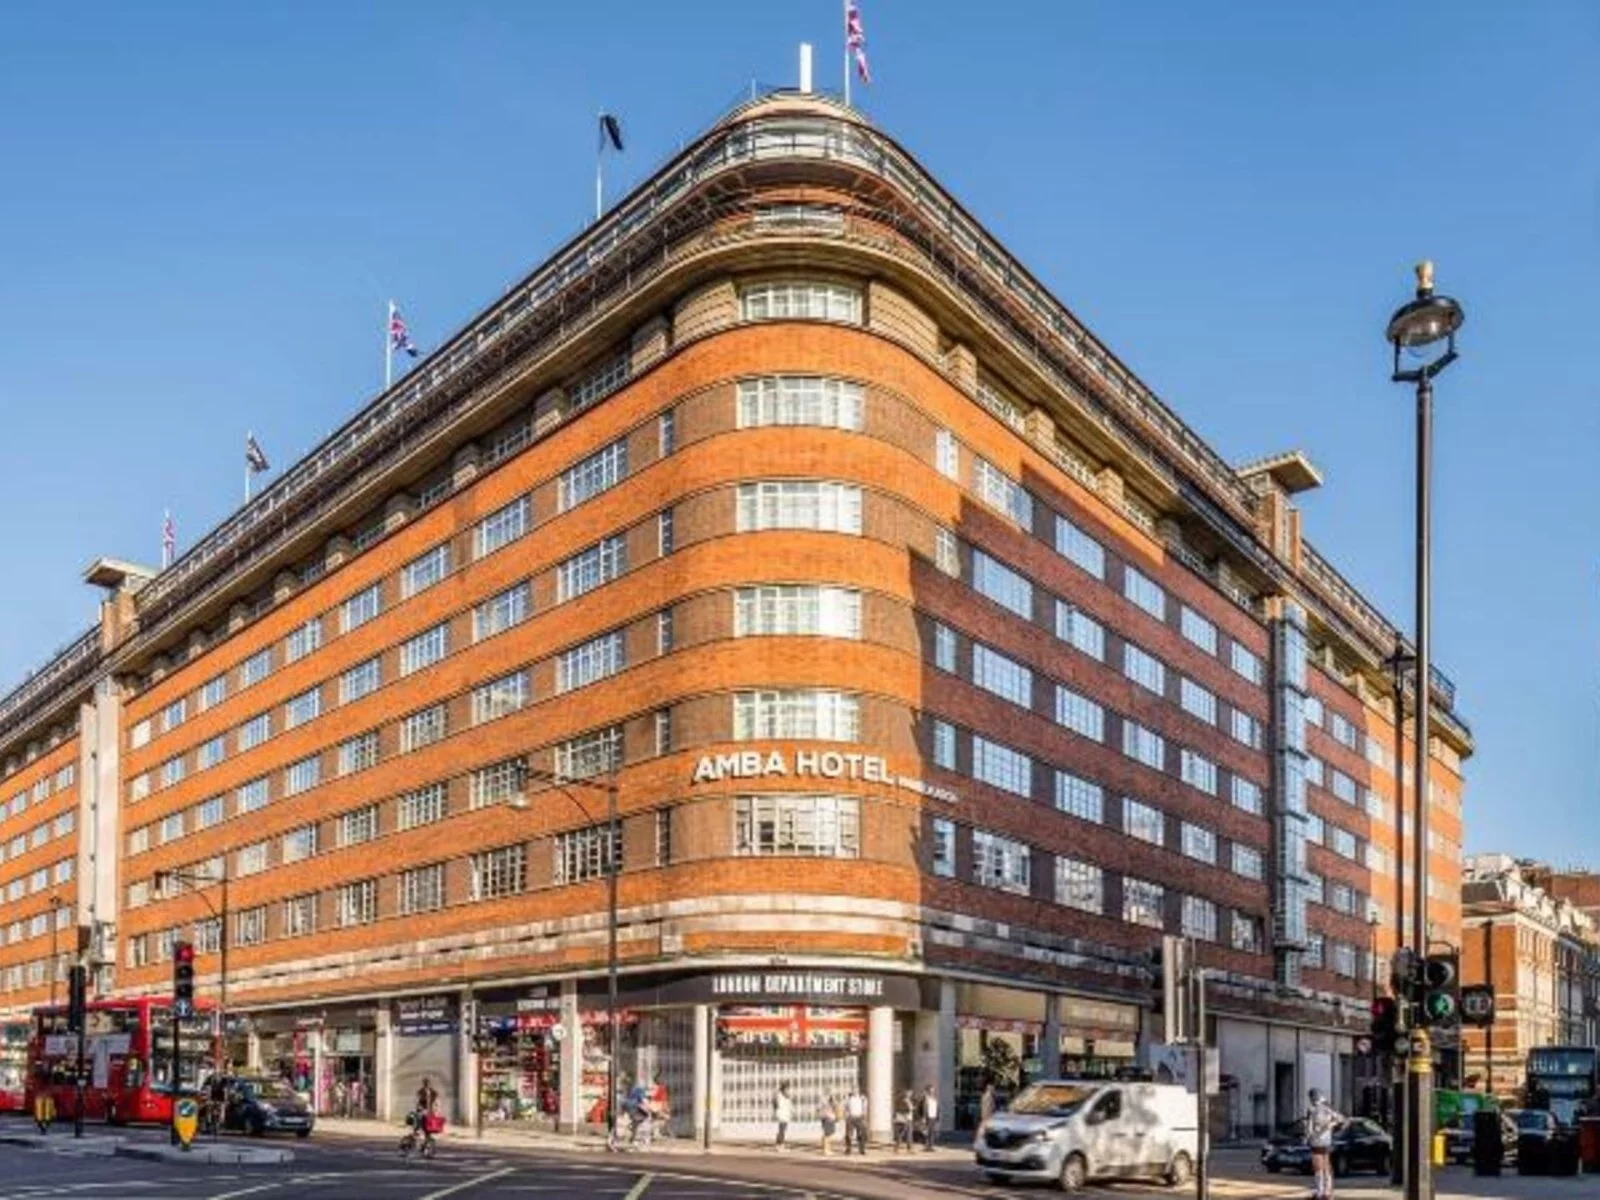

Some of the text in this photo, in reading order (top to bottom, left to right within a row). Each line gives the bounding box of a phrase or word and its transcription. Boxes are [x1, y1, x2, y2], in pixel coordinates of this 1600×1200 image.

[693, 750, 895, 785] AMBA HOTEL
[713, 974, 884, 996] LONDON DEPARTMENT STORE
